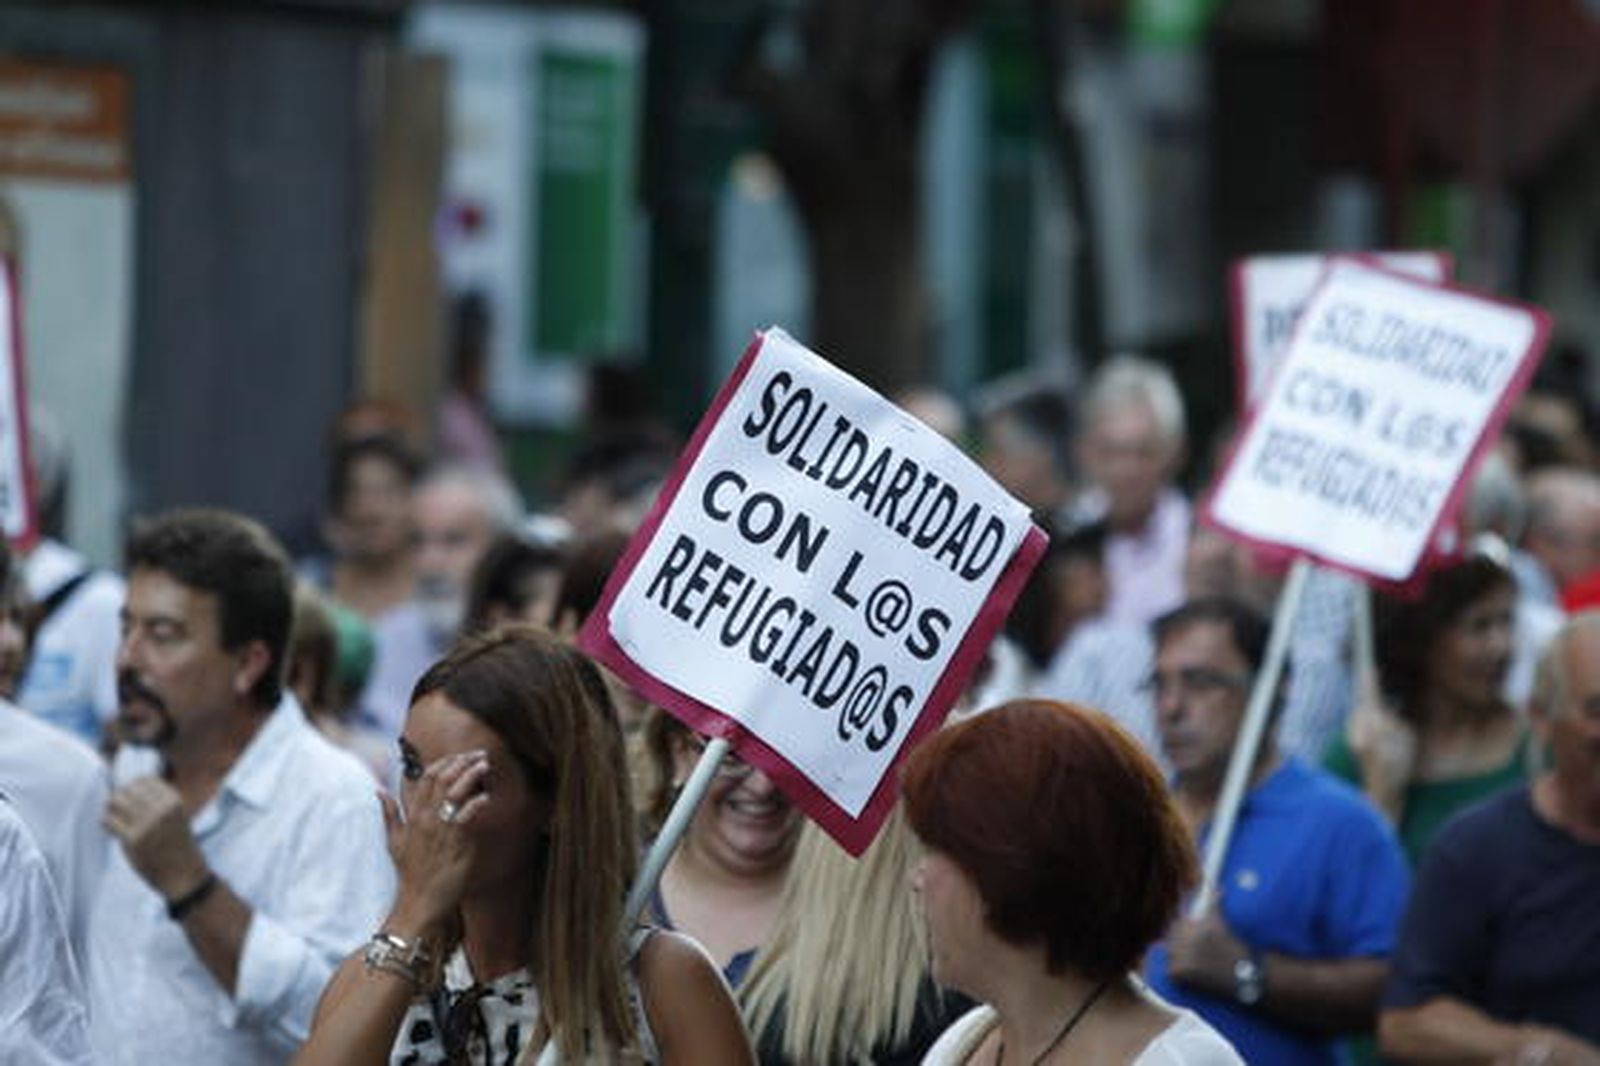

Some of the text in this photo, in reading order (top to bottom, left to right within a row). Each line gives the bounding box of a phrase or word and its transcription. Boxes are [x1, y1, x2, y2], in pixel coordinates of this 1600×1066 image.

[702, 470, 951, 660] CON L@S
[743, 370, 1006, 581] SOLIDARIDAD
[645, 534, 914, 752] REFUGIAD@S
